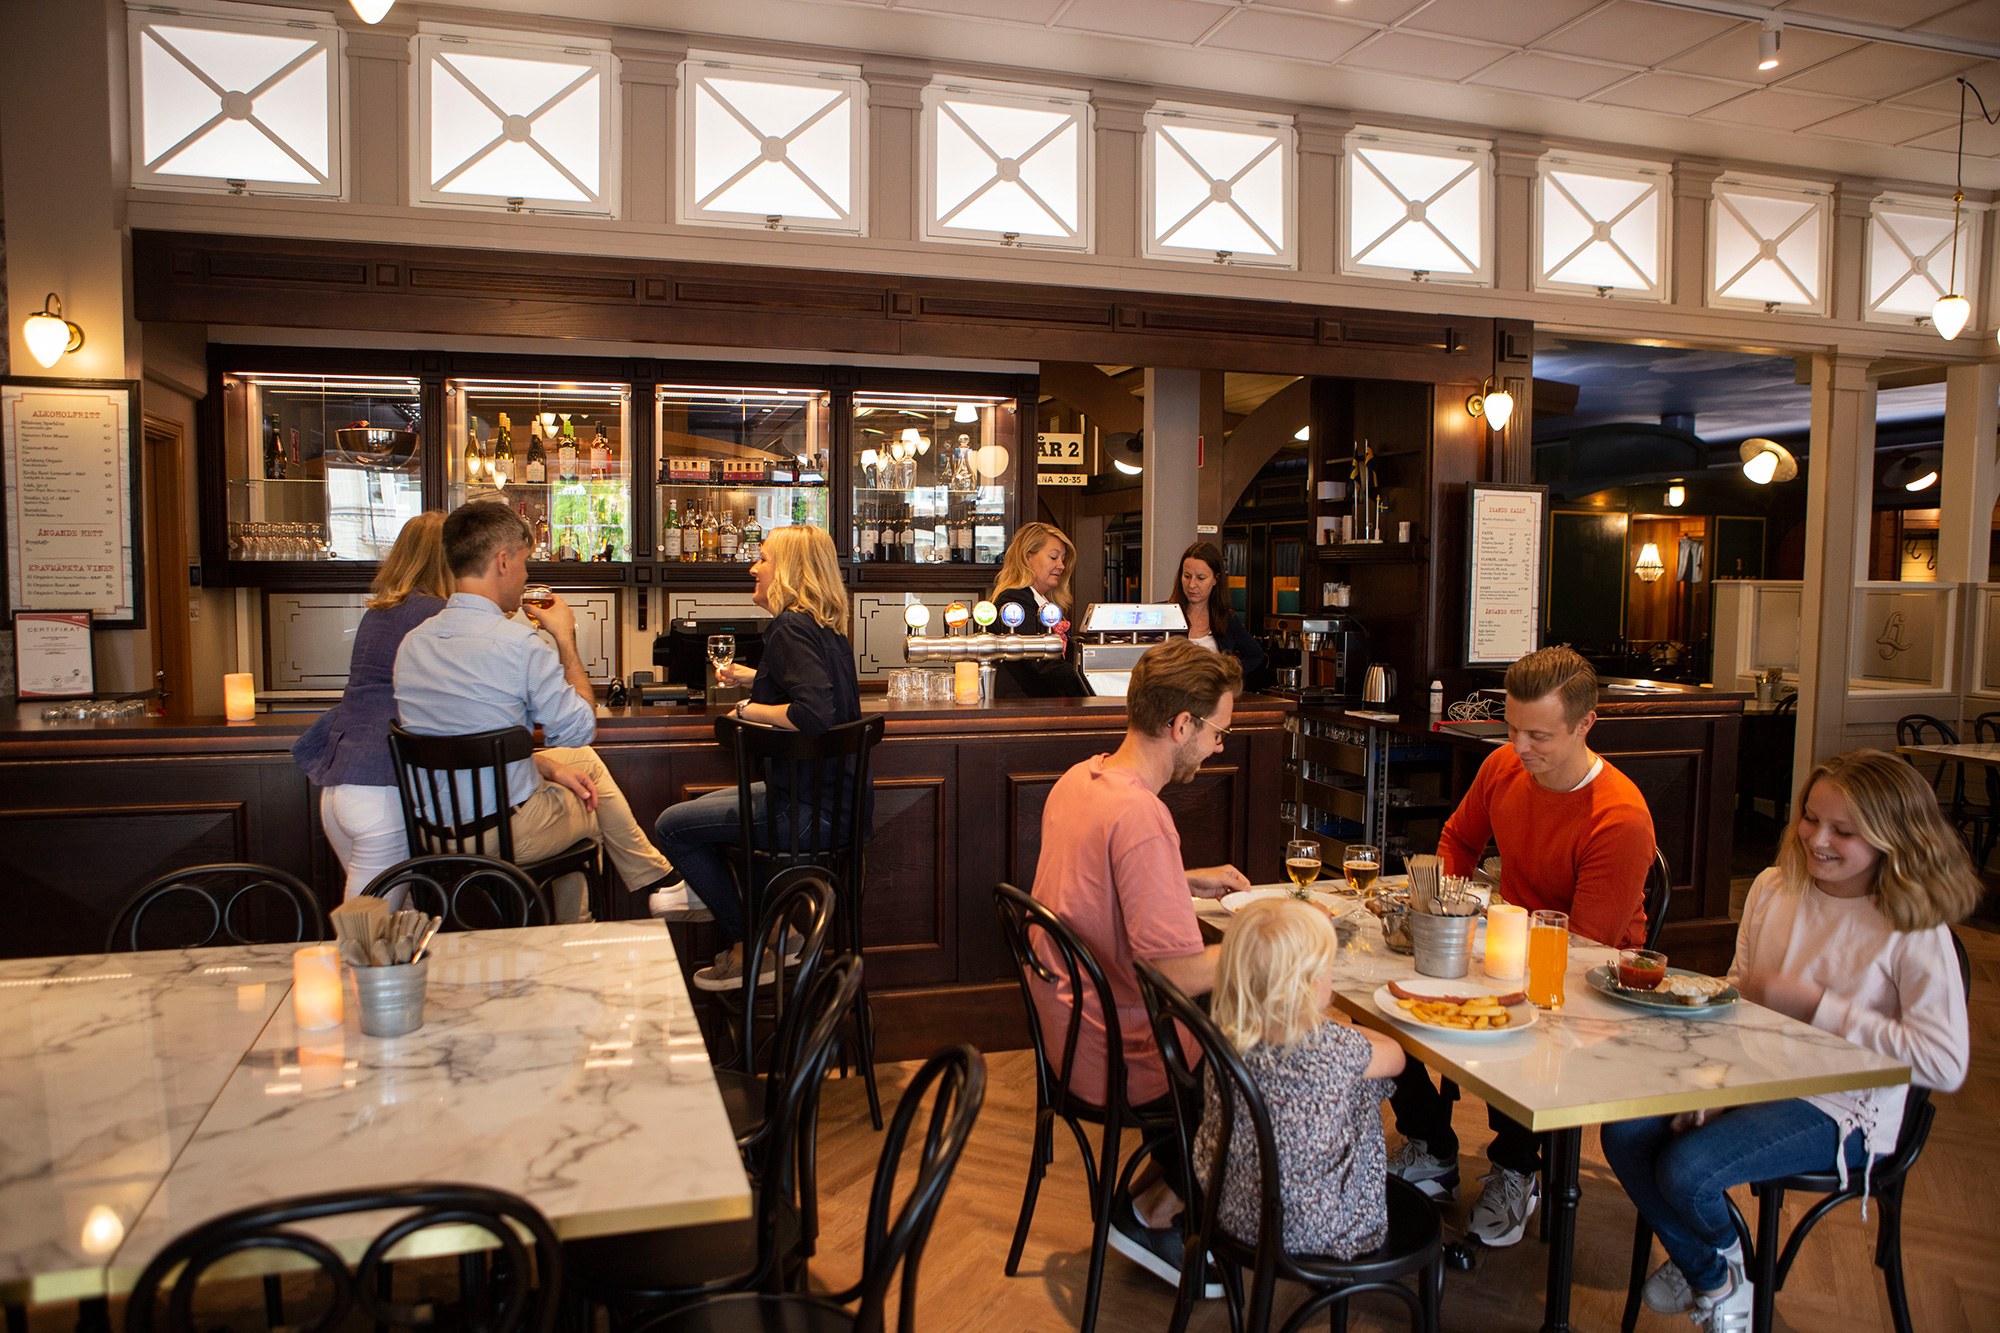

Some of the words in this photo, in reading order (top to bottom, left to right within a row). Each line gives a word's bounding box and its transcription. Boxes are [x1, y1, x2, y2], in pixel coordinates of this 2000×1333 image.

[32, 411, 101, 419] ALKOHOLFRITT
[1068, 441, 1080, 457] 2
[37, 528, 78, 537] ÅNGANDE
[87, 564, 115, 572] VINER
[1113, 611, 1163, 625] PEPSI
